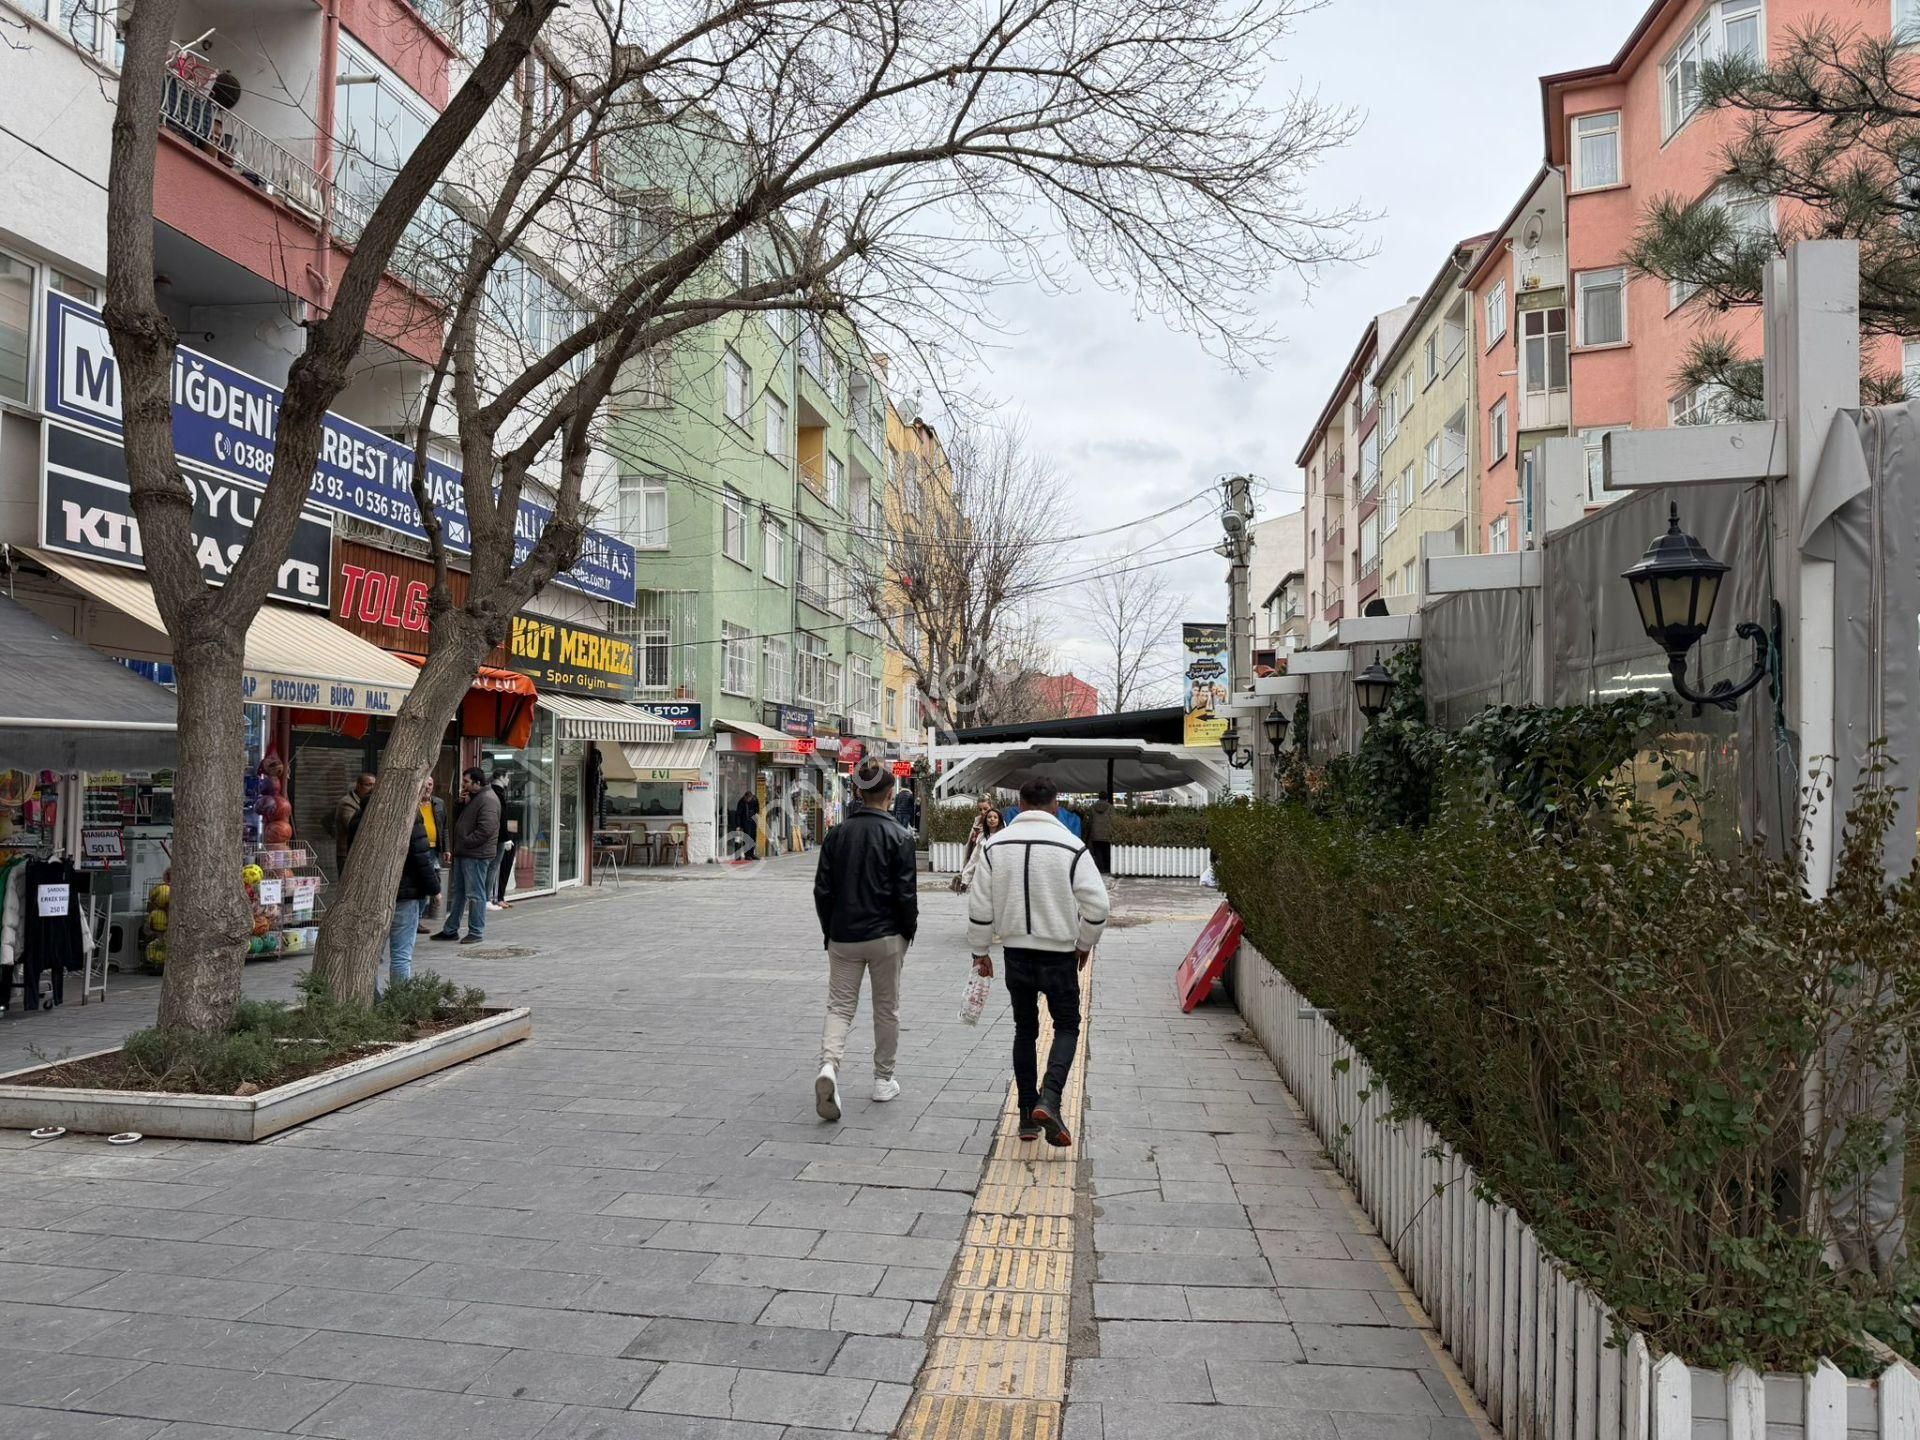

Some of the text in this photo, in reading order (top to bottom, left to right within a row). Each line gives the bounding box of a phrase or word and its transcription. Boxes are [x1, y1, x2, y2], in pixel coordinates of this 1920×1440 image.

[169, 355, 280, 441] İĞDENİ
[318, 425, 388, 484] RBEST
[392, 456, 469, 517] MHASE
[327, 475, 343, 500] 93
[366, 491, 388, 517] 536
[390, 499, 411, 524] 378
[340, 563, 430, 634] TOLG
[511, 616, 555, 662] KOT
[243, 675, 257, 698] AP
[271, 679, 320, 704] FOTOKOPİ
[330, 682, 354, 707] BÜRO
[366, 690, 391, 710] MALZ.
[472, 677, 489, 688] AY
[546, 669, 606, 690] Spor Giyim
[654, 706, 689, 715] STOP
[651, 769, 670, 779] EVİ
[92, 844, 117, 854] 50 TL
